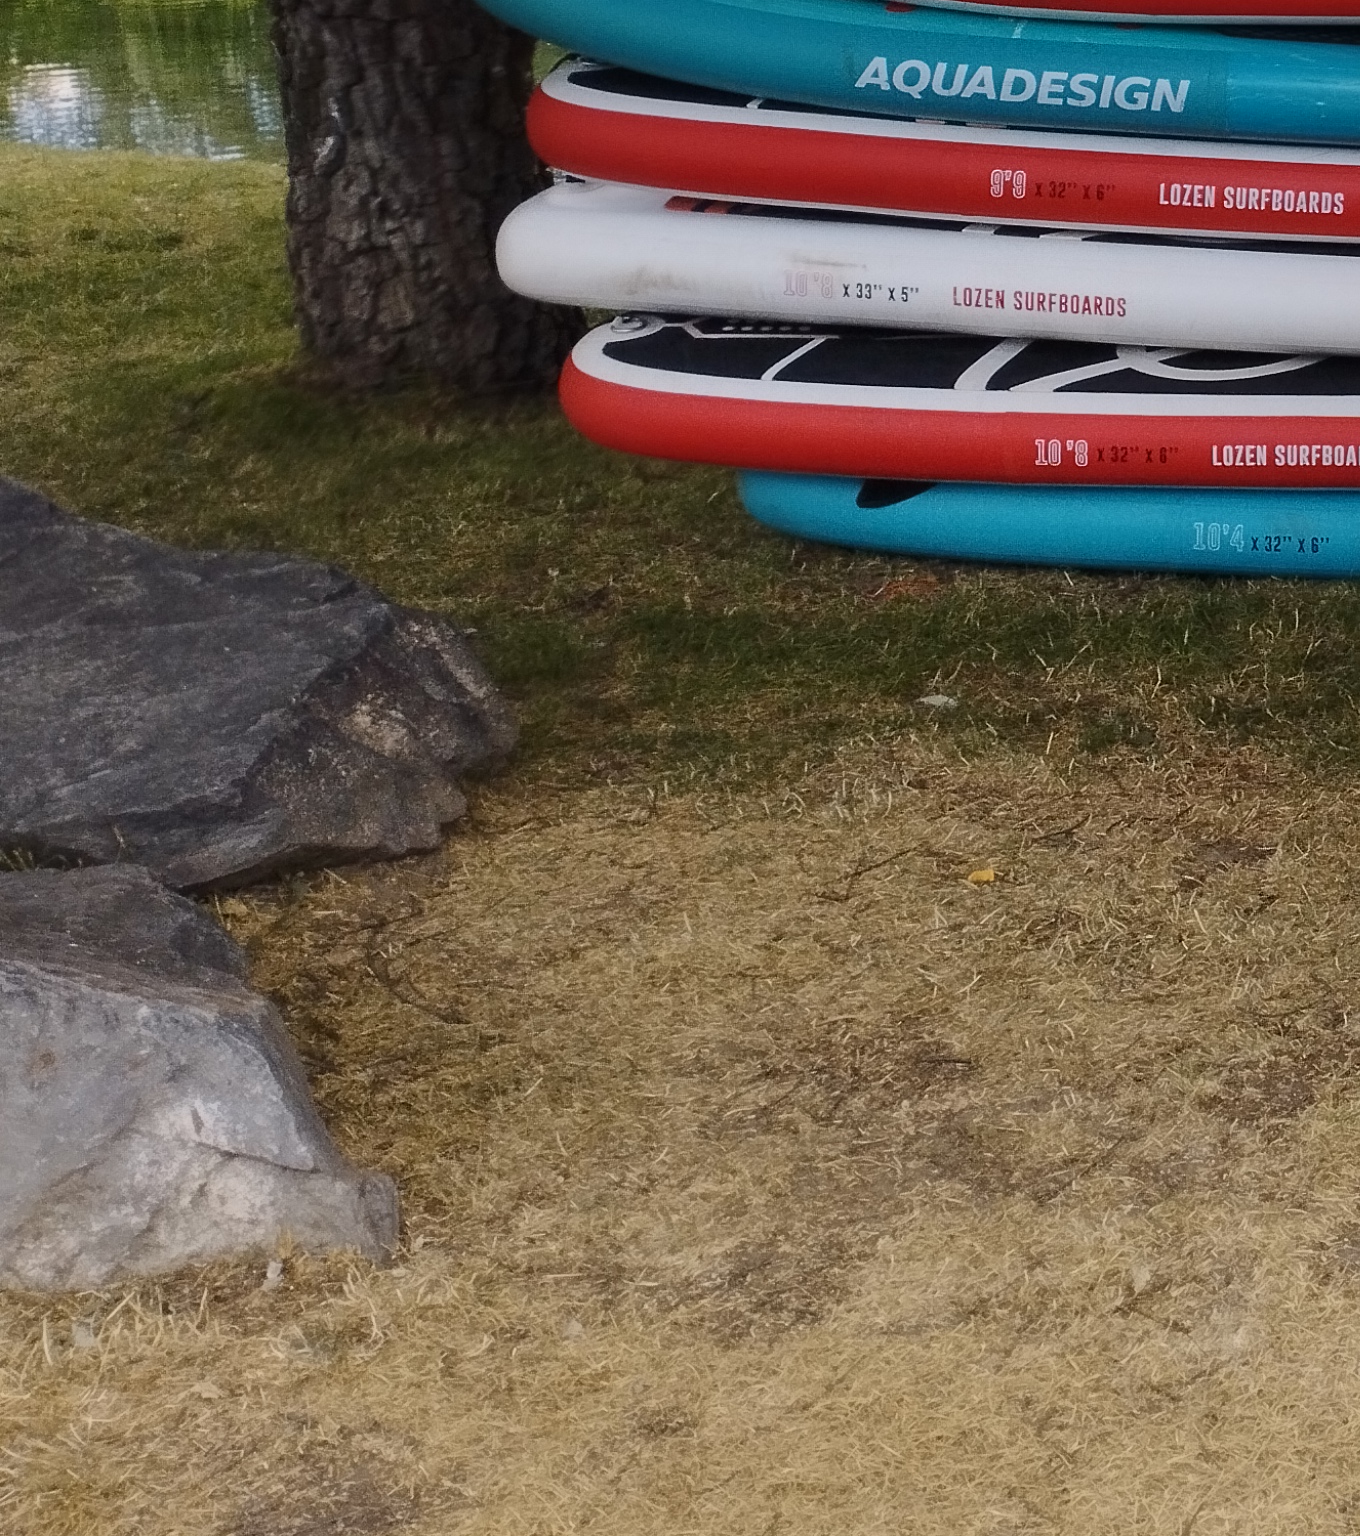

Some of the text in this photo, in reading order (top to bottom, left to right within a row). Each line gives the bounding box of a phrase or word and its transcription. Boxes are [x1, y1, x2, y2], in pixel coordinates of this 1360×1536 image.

[854, 56, 1190, 114] AQUADESIGN
[1159, 182, 1344, 215] LOZEN SURFBOARDS
[953, 286, 1127, 318] LOZEN SURFBOARDS
[1211, 444, 1267, 467] LOZEN
